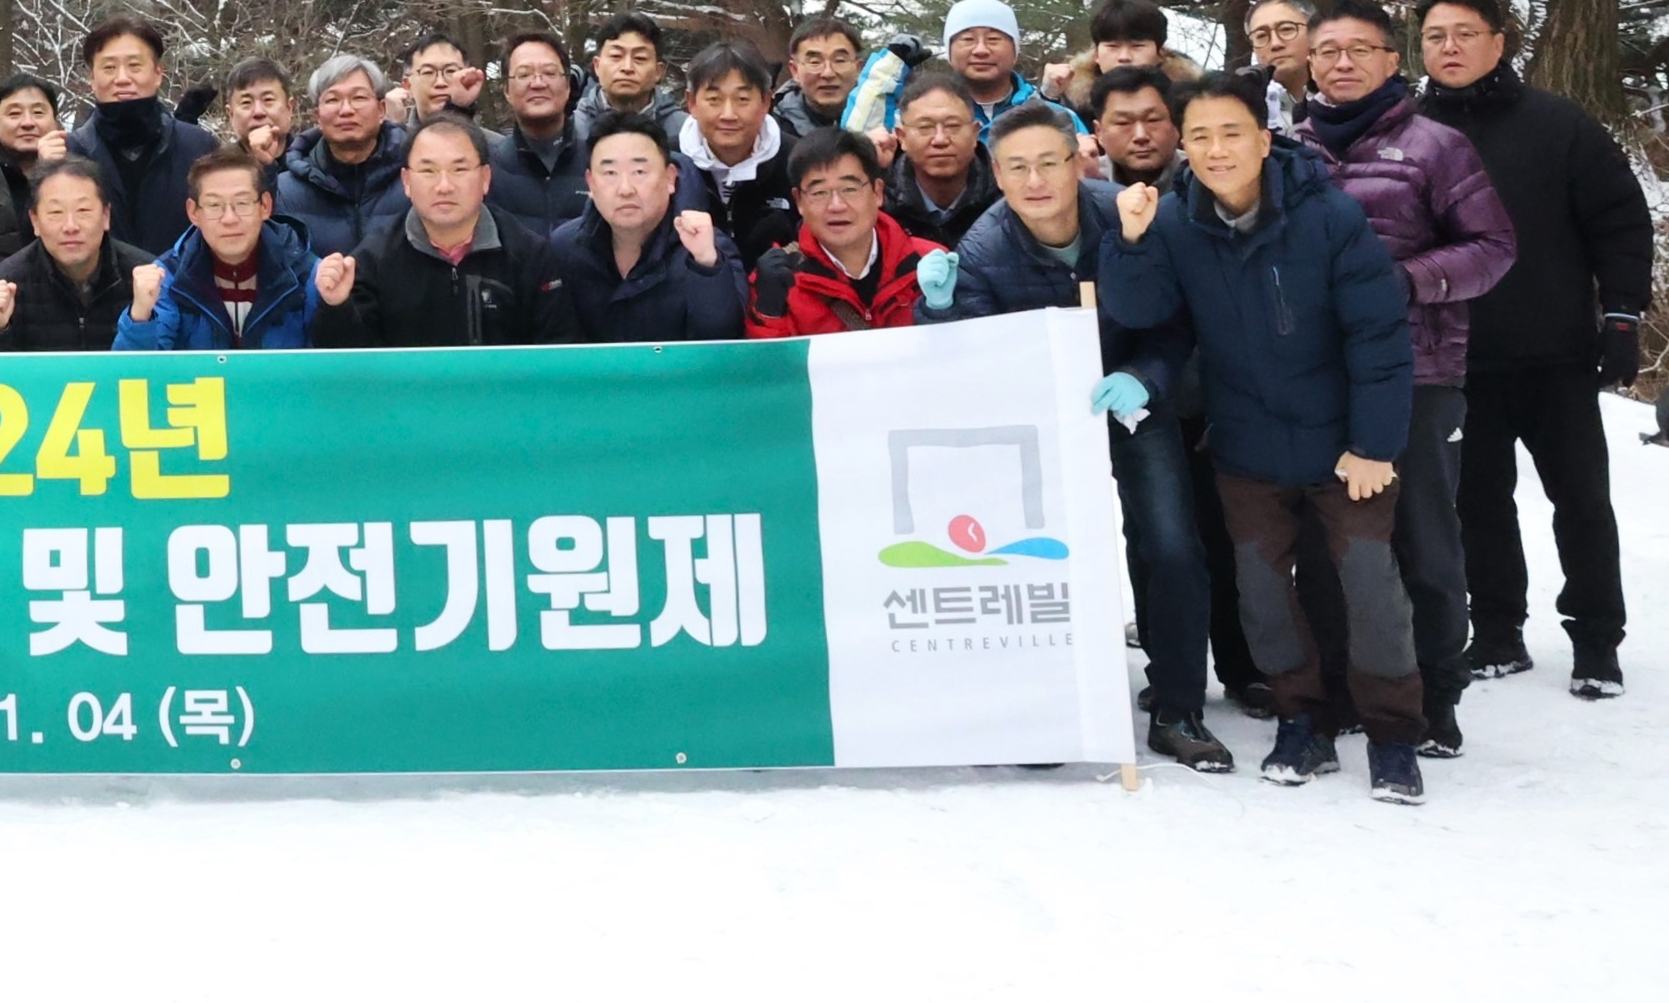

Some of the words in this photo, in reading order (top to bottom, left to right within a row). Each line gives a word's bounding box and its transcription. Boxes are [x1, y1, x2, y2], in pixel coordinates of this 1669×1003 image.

[22, 527, 128, 656] 및
[167, 513, 767, 654] 안전기원제
[882, 582, 1071, 630] 센트레빌
[891, 633, 1073, 652] CENTREVILLE
[67, 692, 136, 742] 04
[158, 686, 255, 747] (목)
